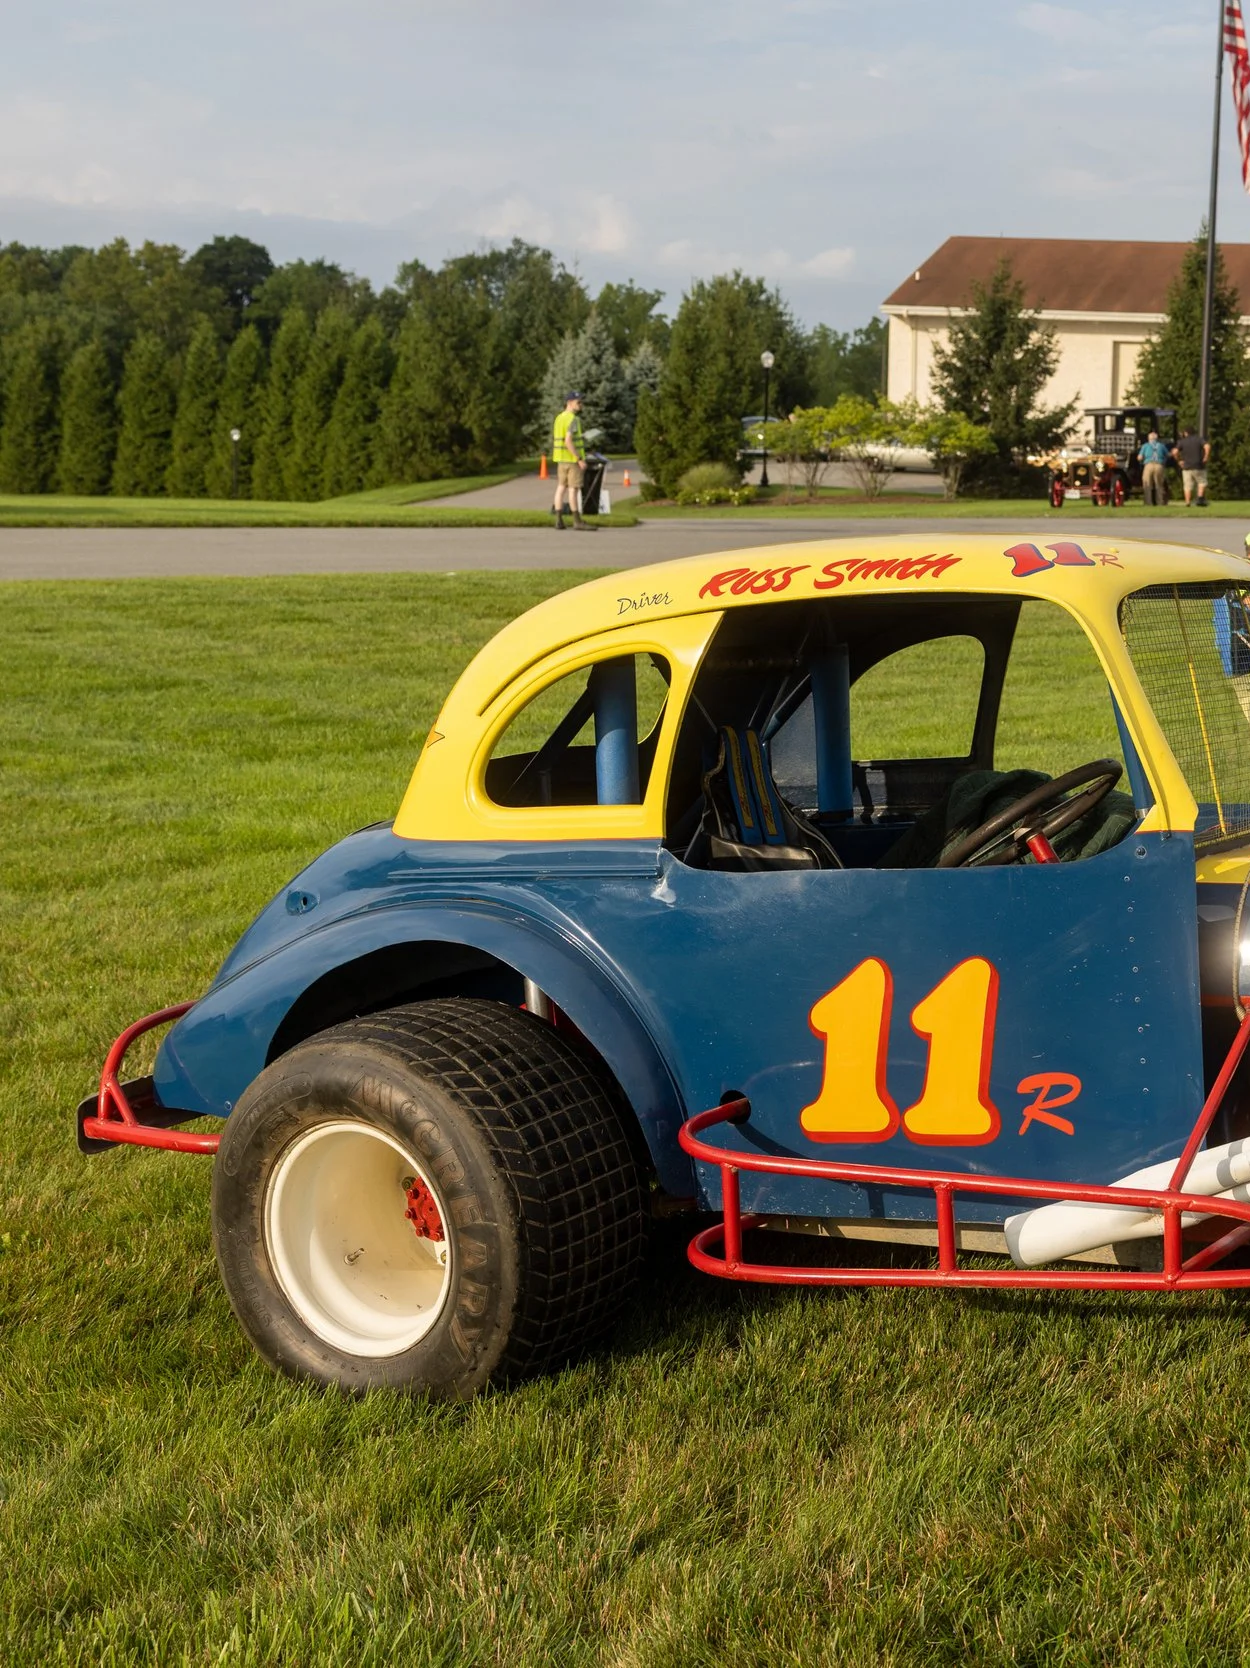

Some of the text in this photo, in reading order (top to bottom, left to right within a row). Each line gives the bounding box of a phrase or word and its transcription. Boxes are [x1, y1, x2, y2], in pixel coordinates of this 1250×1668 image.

[617, 592, 673, 615] Driver
[1003, 541, 1096, 578] 11
[1092, 553, 1124, 569] R
[799, 956, 1082, 1146] 11 R
